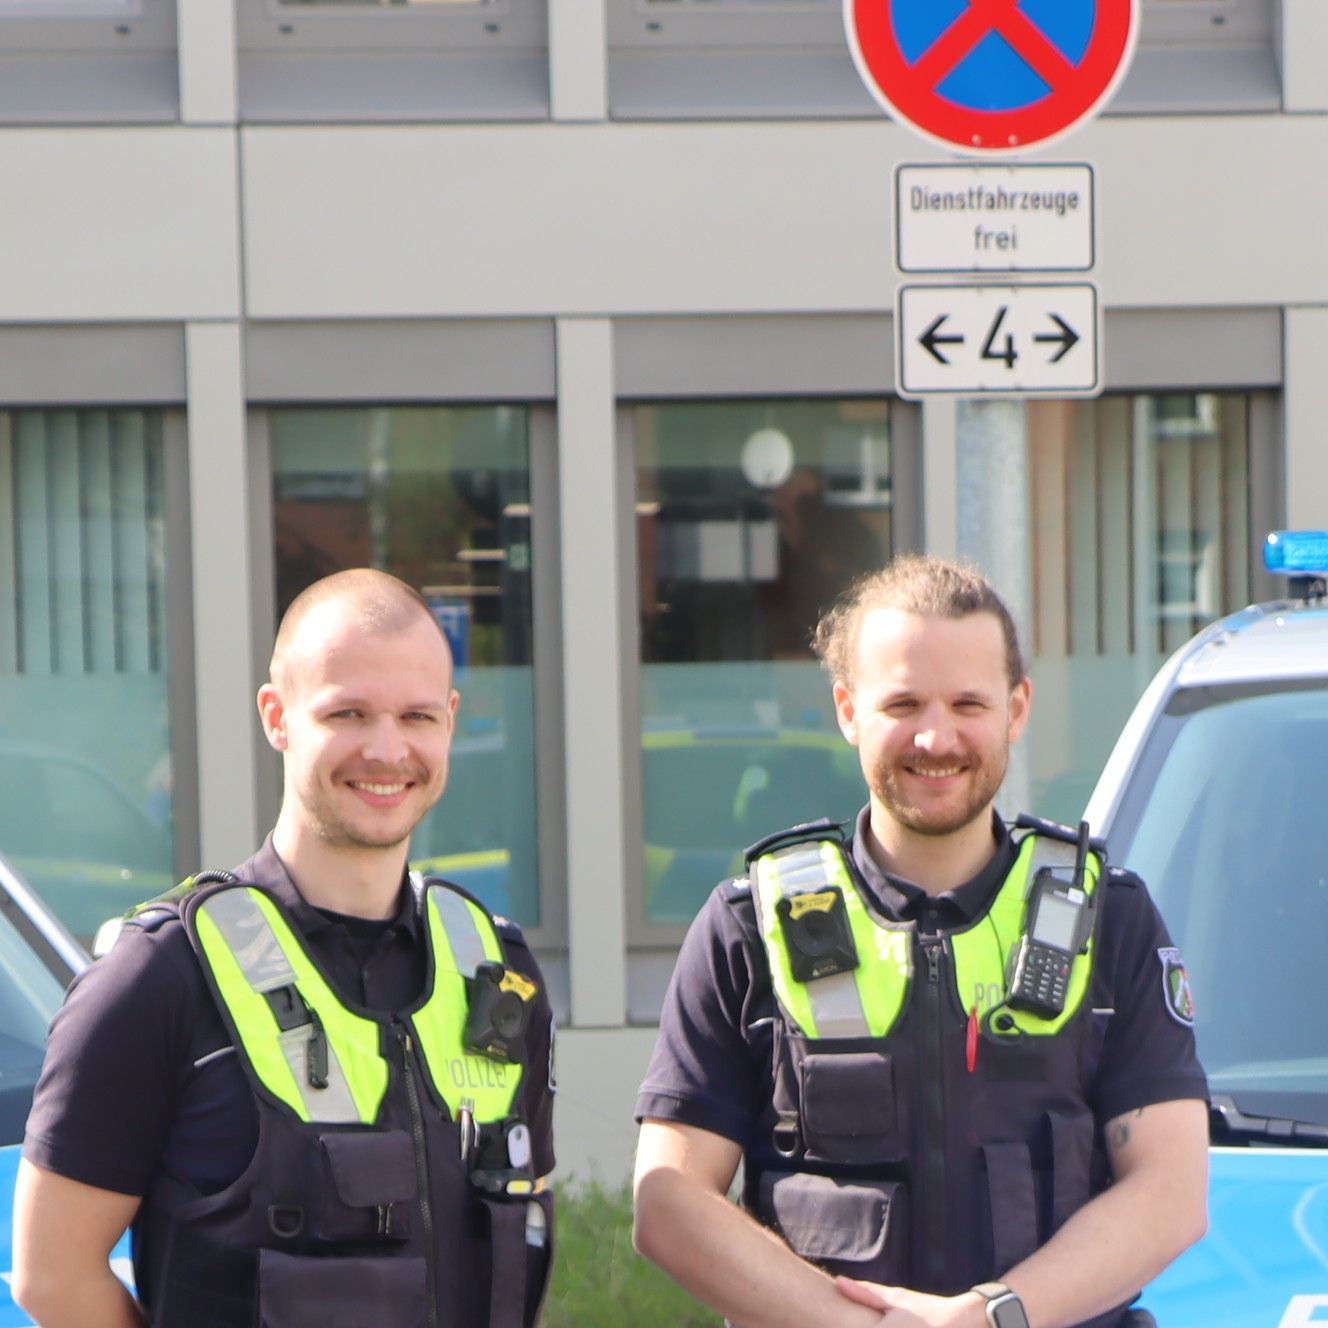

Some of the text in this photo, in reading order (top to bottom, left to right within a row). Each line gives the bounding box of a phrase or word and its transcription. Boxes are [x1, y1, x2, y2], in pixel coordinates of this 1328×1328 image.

[910, 186, 1079, 216] Dienstfahrzeuge
[974, 225, 1018, 250] frei
[980, 306, 1018, 369] 4
[445, 1057, 508, 1088] OLIZE
